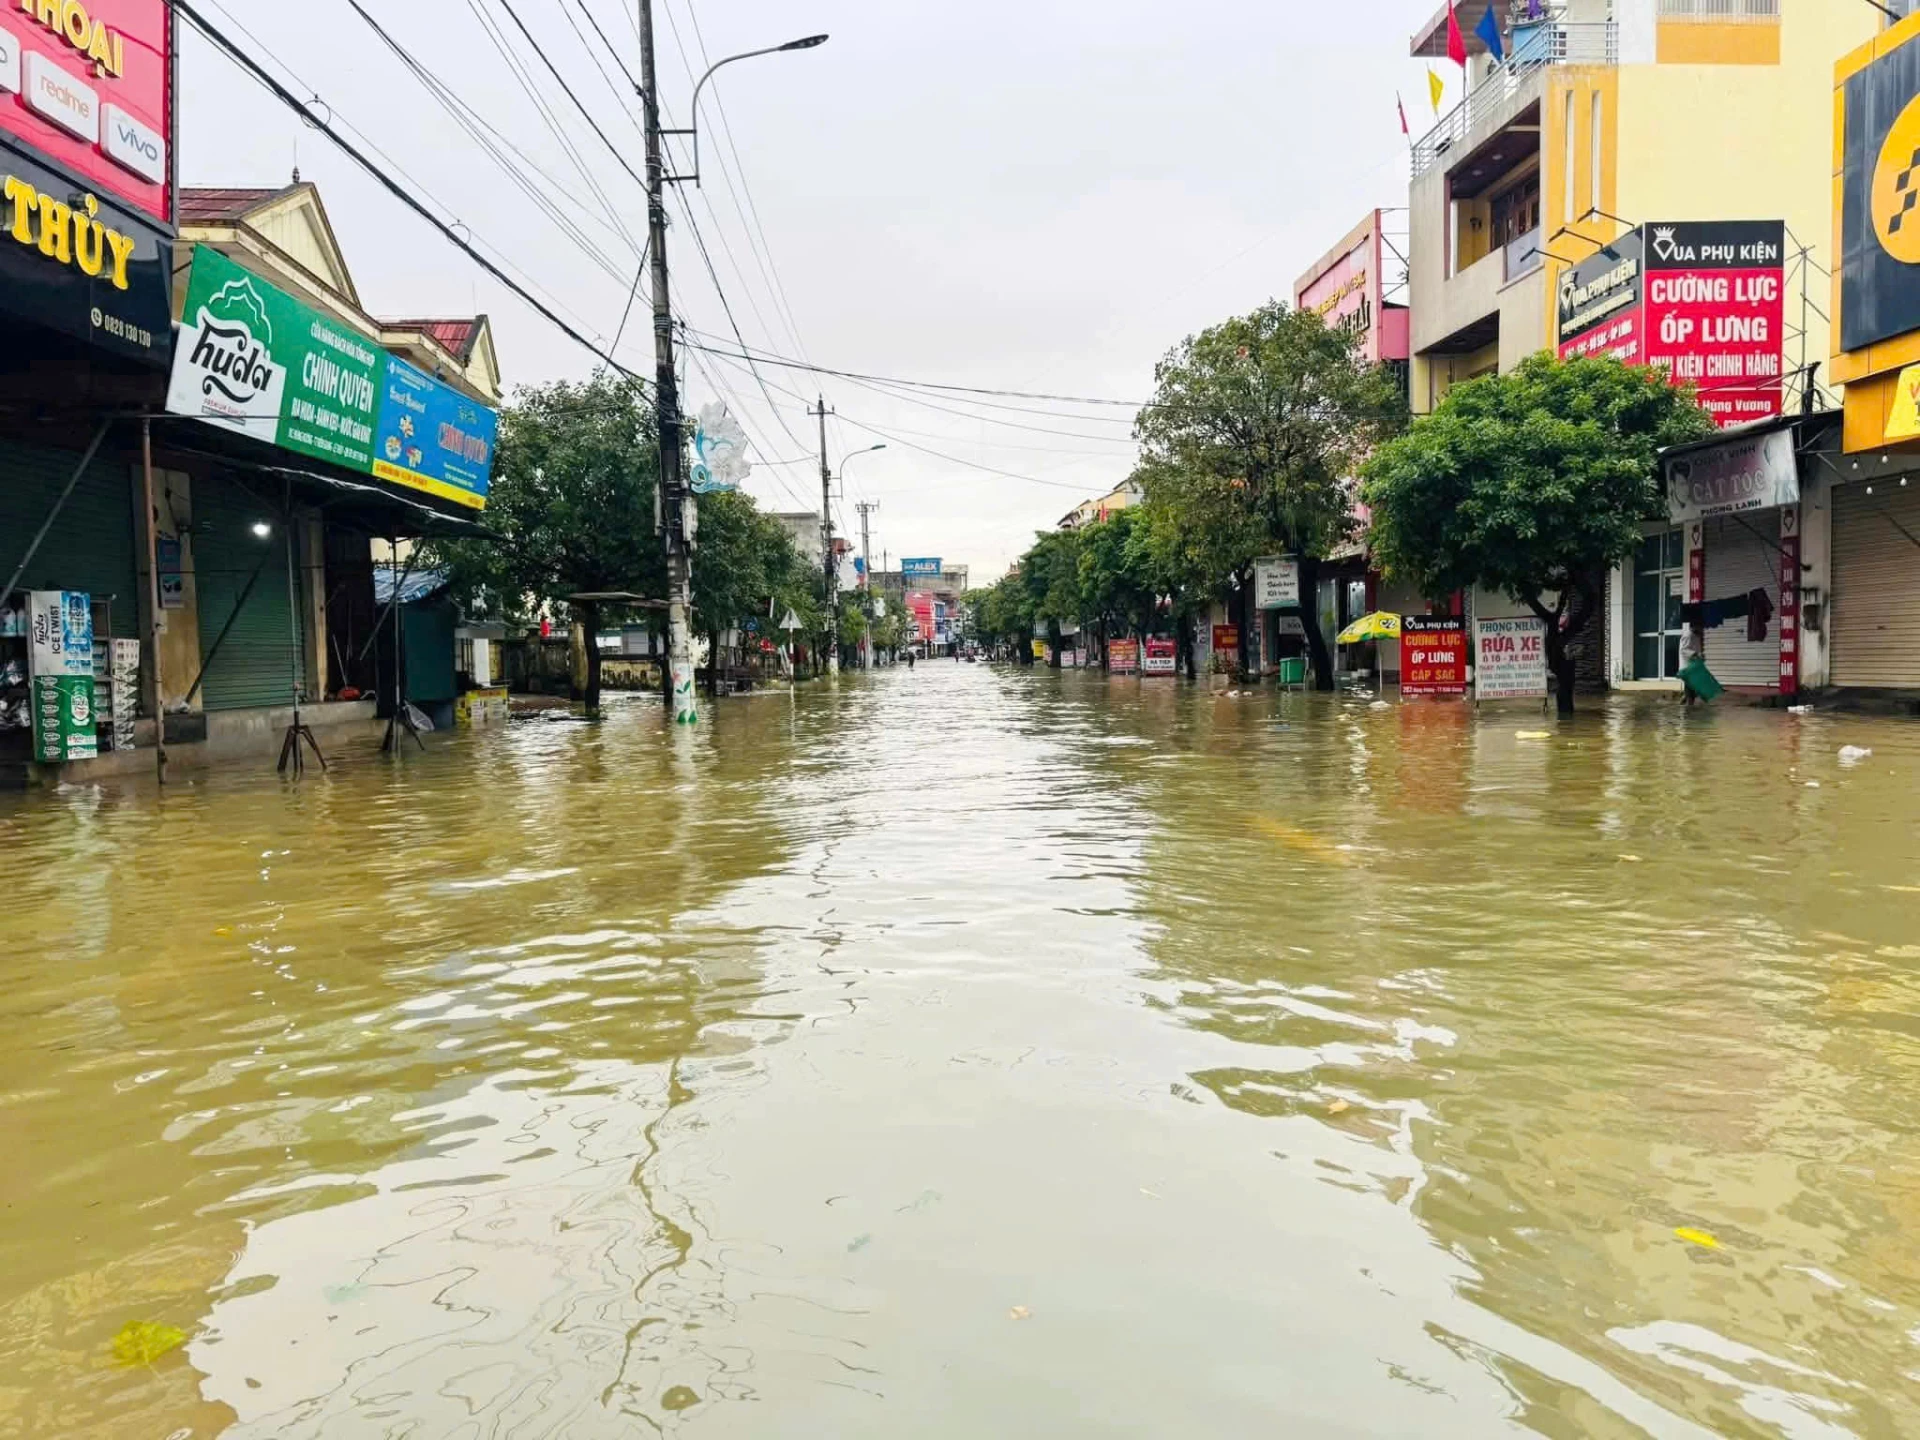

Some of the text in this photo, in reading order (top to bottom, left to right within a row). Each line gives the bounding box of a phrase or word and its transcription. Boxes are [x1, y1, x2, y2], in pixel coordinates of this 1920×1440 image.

[22, 0, 122, 78] HOẠI
[40, 75, 90, 118] realme
[118, 124, 158, 161] vivo
[5, 175, 135, 290] THỦY
[1701, 245, 1735, 265] PHỤ
[1740, 241, 1777, 264] KIỆN
[1651, 273, 1729, 304] CƯỜNG
[1735, 277, 1777, 307] LỰC
[104, 315, 151, 347] 0828 130 130
[1660, 310, 1768, 343] ỐP LƯNG
[190, 316, 272, 392] huda
[1676, 351, 1703, 378] KIỆN
[1706, 349, 1743, 377] CHÍNH
[303, 350, 340, 399] CHÍNH
[914, 562, 937, 571] ALEX
[50, 605, 61, 654] ICE TWIST
[1405, 632, 1460, 647] CƯỜNG LỰC
[1481, 633, 1541, 653] RỬA XE
[1411, 650, 1455, 664] ỐP LƯNG
